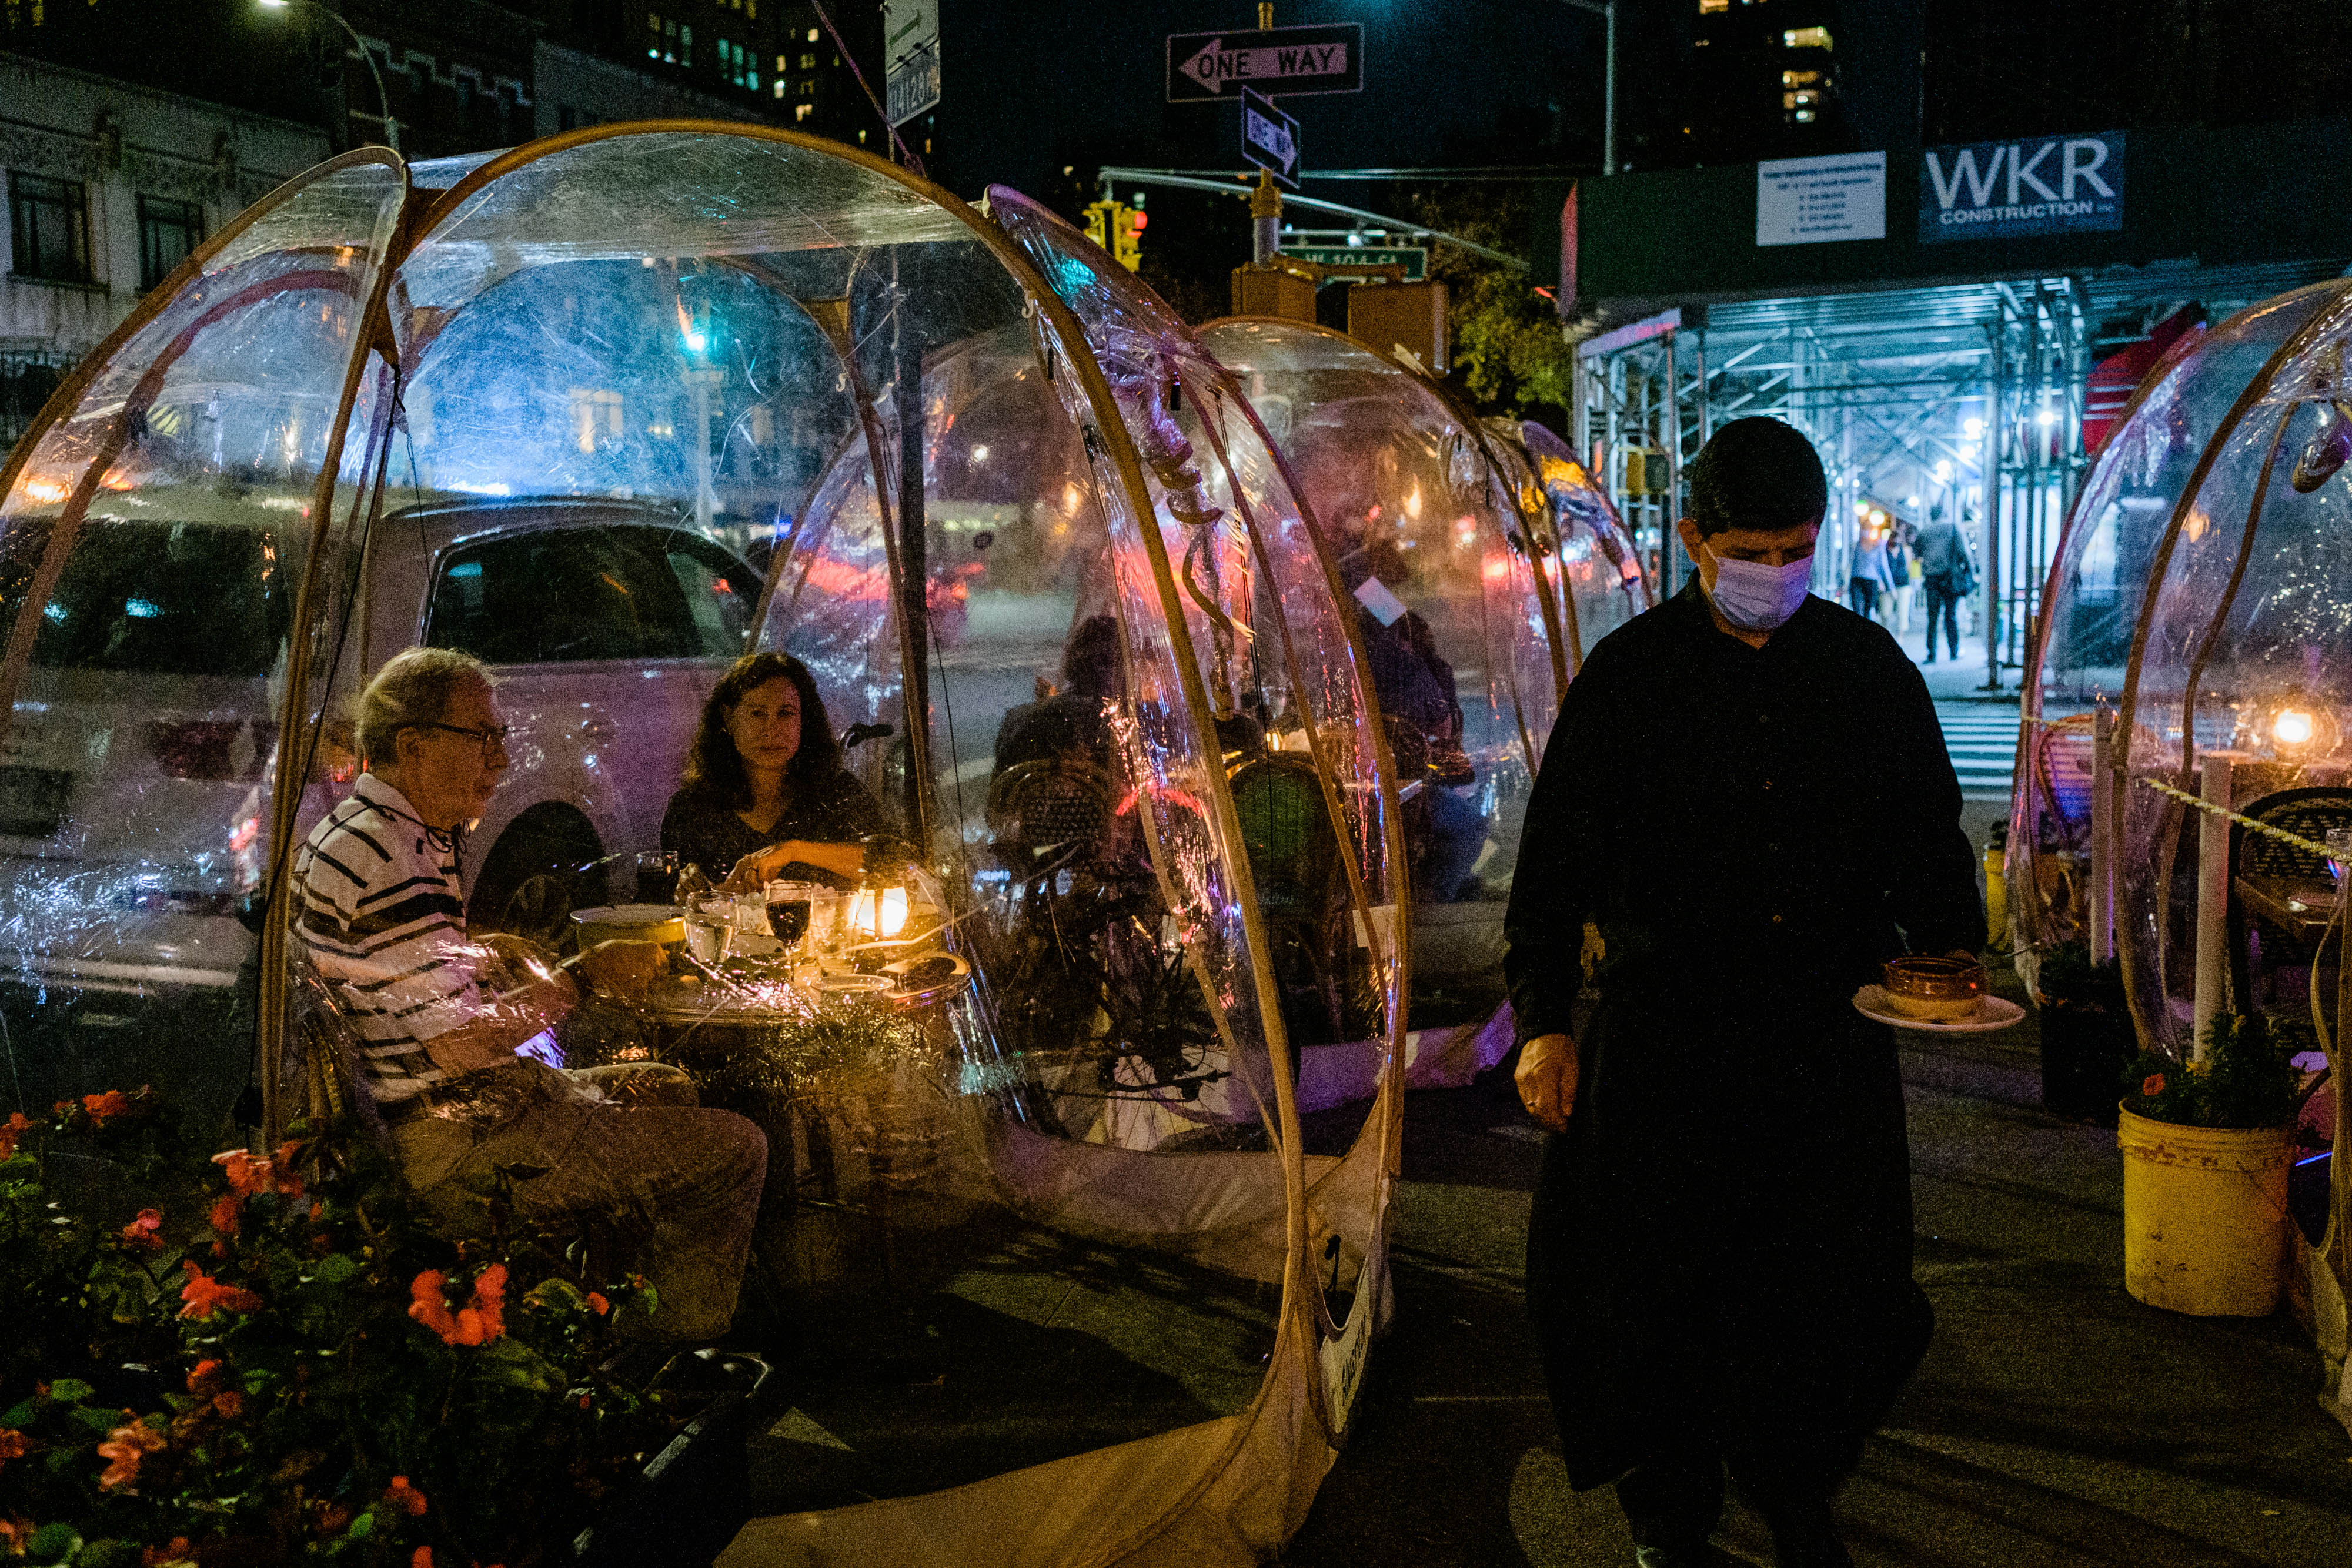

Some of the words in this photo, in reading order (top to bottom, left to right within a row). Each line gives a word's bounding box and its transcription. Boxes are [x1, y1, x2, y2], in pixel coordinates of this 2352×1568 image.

[1198, 54, 1251, 78] ONE
[1278, 46, 1335, 75] WAY
[1925, 138, 2116, 209] WKR
[1940, 201, 2093, 225] CONSTRUCTION
